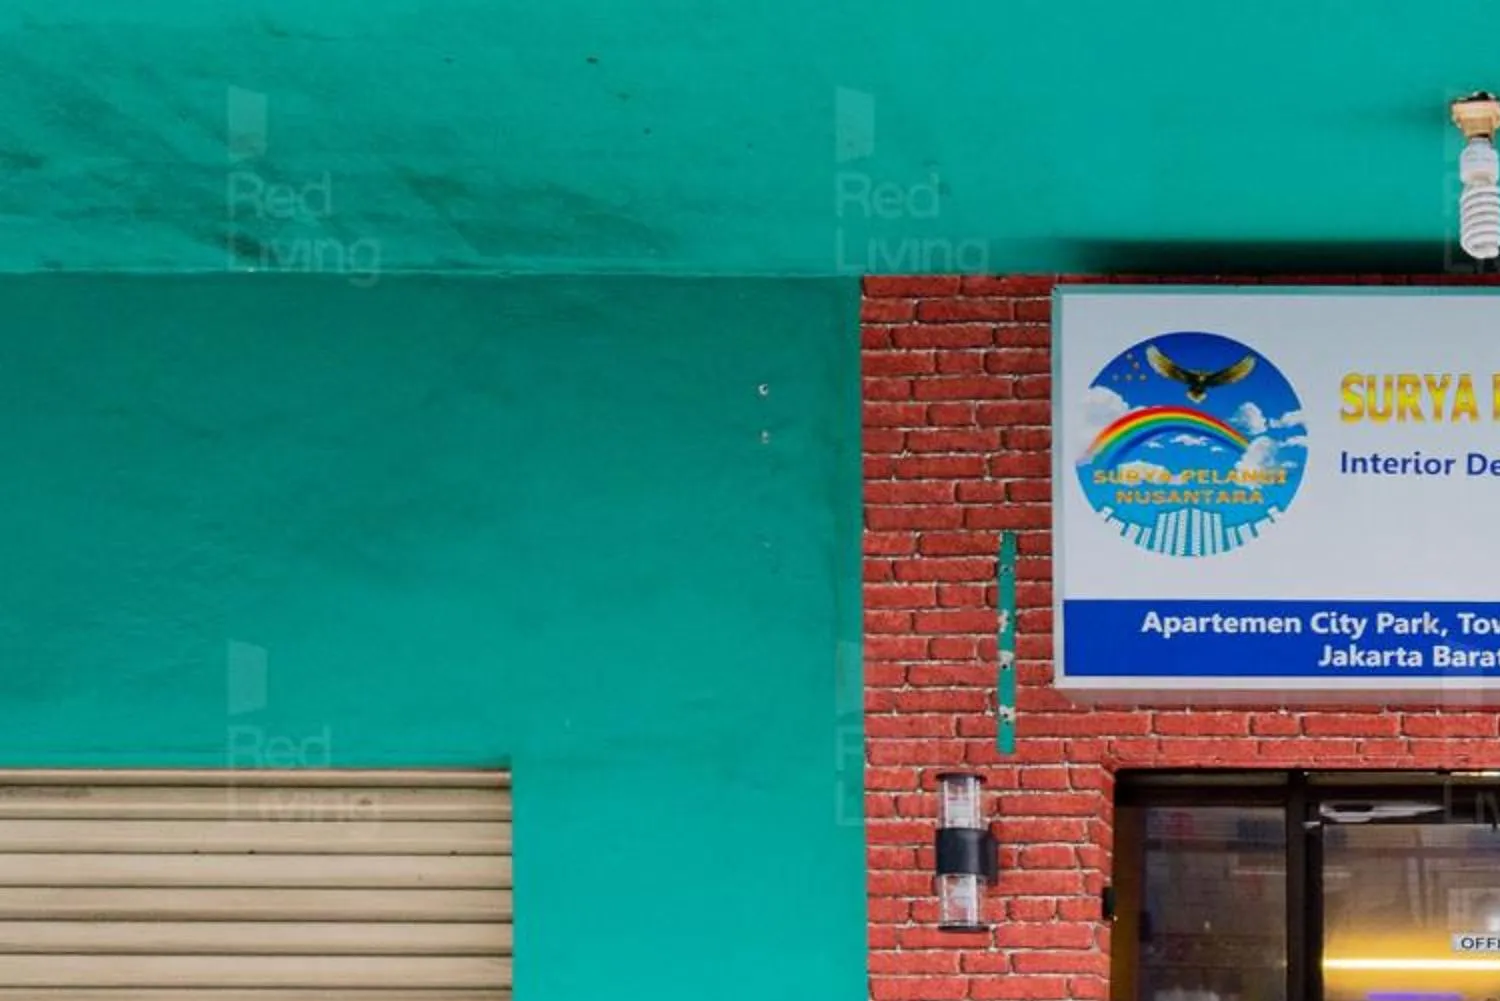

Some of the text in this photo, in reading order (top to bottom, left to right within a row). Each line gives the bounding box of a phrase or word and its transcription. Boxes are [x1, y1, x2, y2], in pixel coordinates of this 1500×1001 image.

[1339, 372, 1479, 424] SURYA
[1340, 451, 1456, 475] Interior
[1093, 469, 1287, 485] SURYA PELANGI
[1115, 489, 1265, 505] NUSANTARA
[1141, 611, 1301, 639] Apartemen
[1310, 612, 1368, 640] City
[1376, 612, 1449, 637] Park,
[1318, 645, 1423, 668] Jakarta
